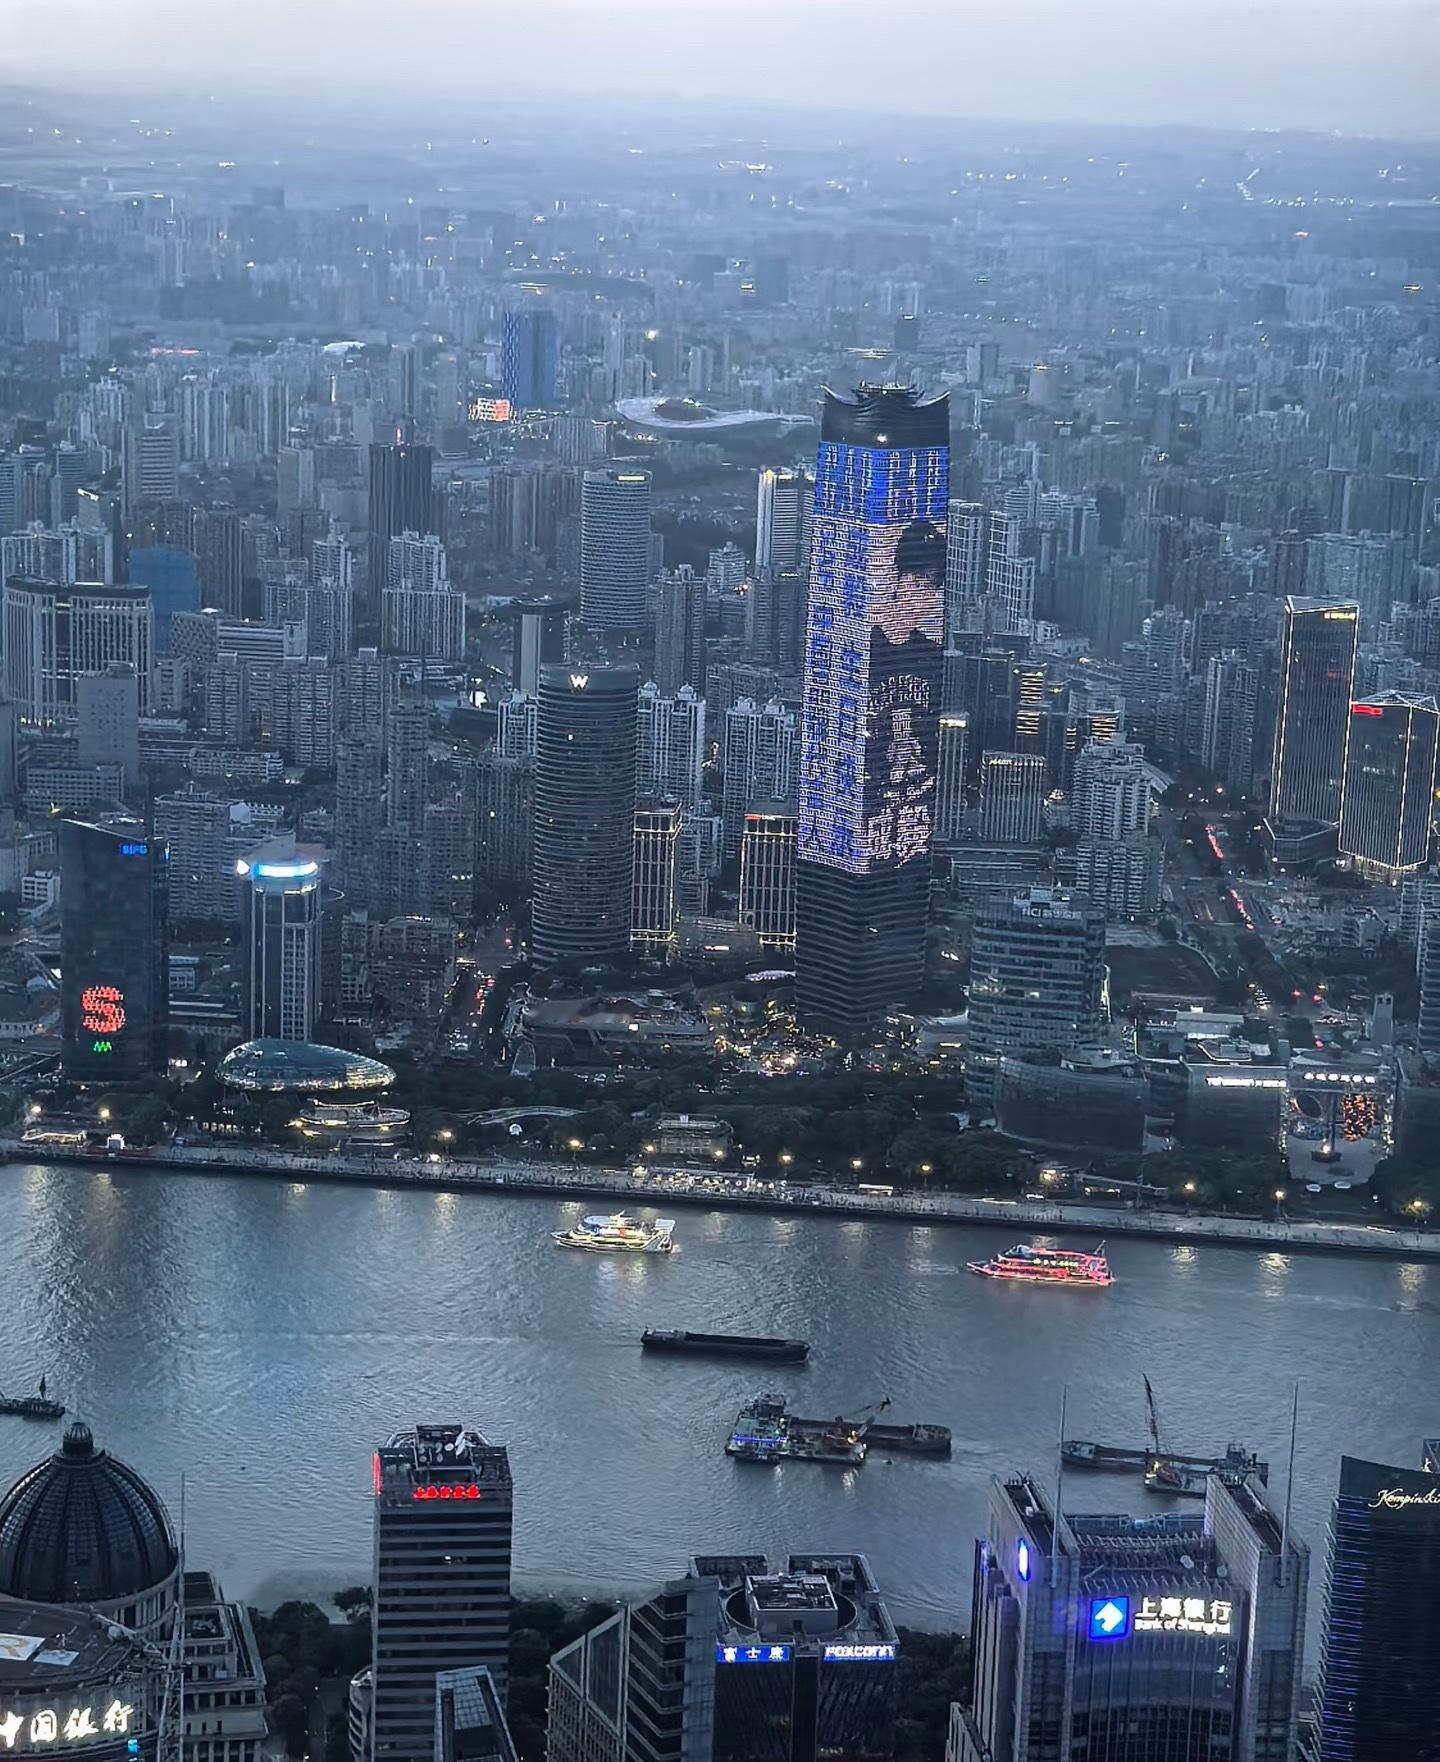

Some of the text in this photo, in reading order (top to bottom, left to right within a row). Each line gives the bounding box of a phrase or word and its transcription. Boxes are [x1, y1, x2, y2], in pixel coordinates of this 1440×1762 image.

[570, 674, 589, 689] W
[1135, 1597, 1232, 1621] 上海银行
[723, 1646, 784, 1663] 富士康
[0, 1699, 134, 1748] 中国银行
